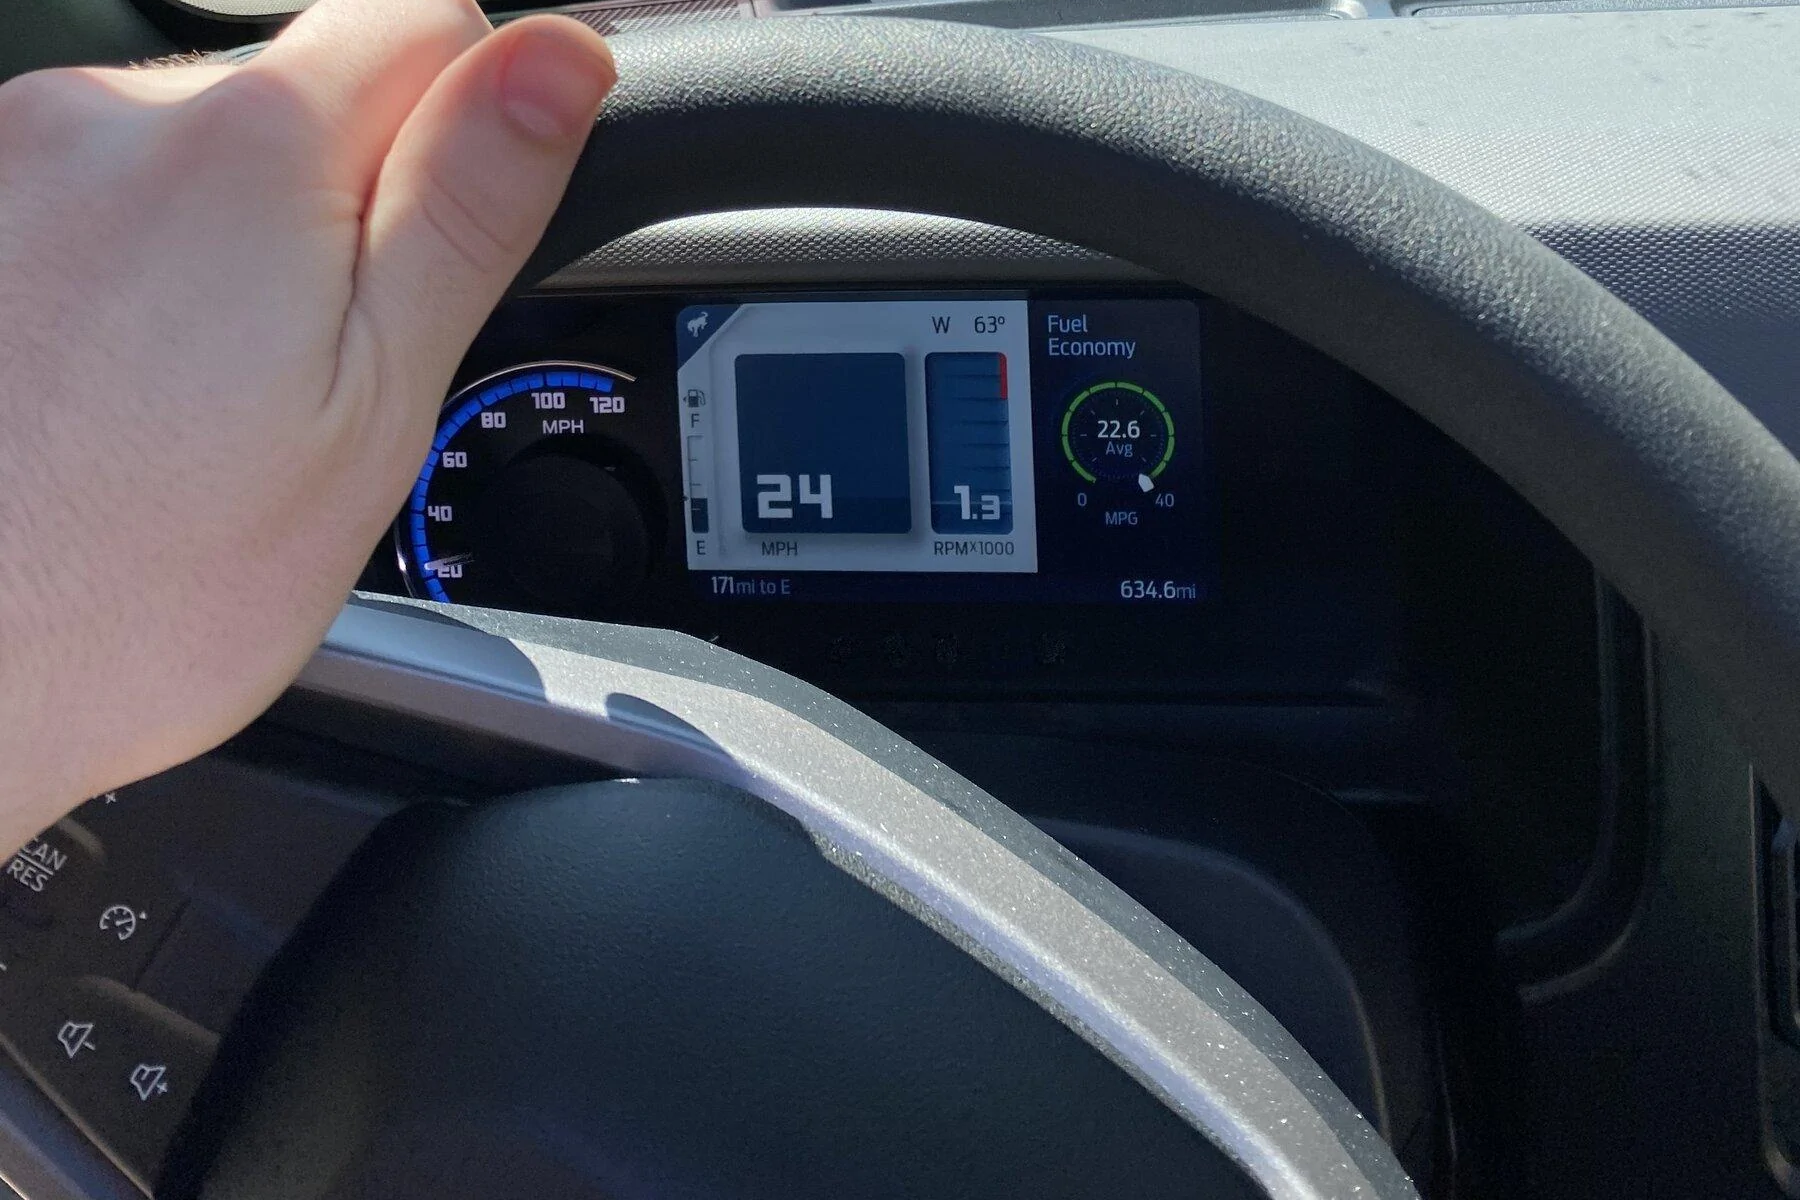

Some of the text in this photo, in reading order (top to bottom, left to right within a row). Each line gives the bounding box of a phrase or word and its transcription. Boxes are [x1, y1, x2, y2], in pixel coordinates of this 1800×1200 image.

[931, 315, 1006, 335] W 63°
[1048, 315, 1089, 334] Fuel
[1048, 337, 1136, 360] Economy
[531, 392, 566, 410] 100
[589, 396, 625, 414] 120
[481, 412, 507, 429] 80
[542, 419, 585, 435] MPH
[690, 413, 701, 428] F
[1097, 420, 1141, 439] 22.6
[1105, 441, 1134, 459] Avg
[442, 452, 468, 469] 60
[755, 474, 834, 520] 24
[954, 485, 1001, 521] 1.3
[1076, 492, 1088, 508] 0
[1155, 492, 1176, 508] 40
[428, 505, 453, 523] 40
[1104, 510, 1139, 527] MPG
[696, 540, 707, 556] E
[761, 541, 798, 557] MPH
[760, 578, 777, 595] to
[781, 579, 792, 595] E
[6, 859, 48, 892] RES
